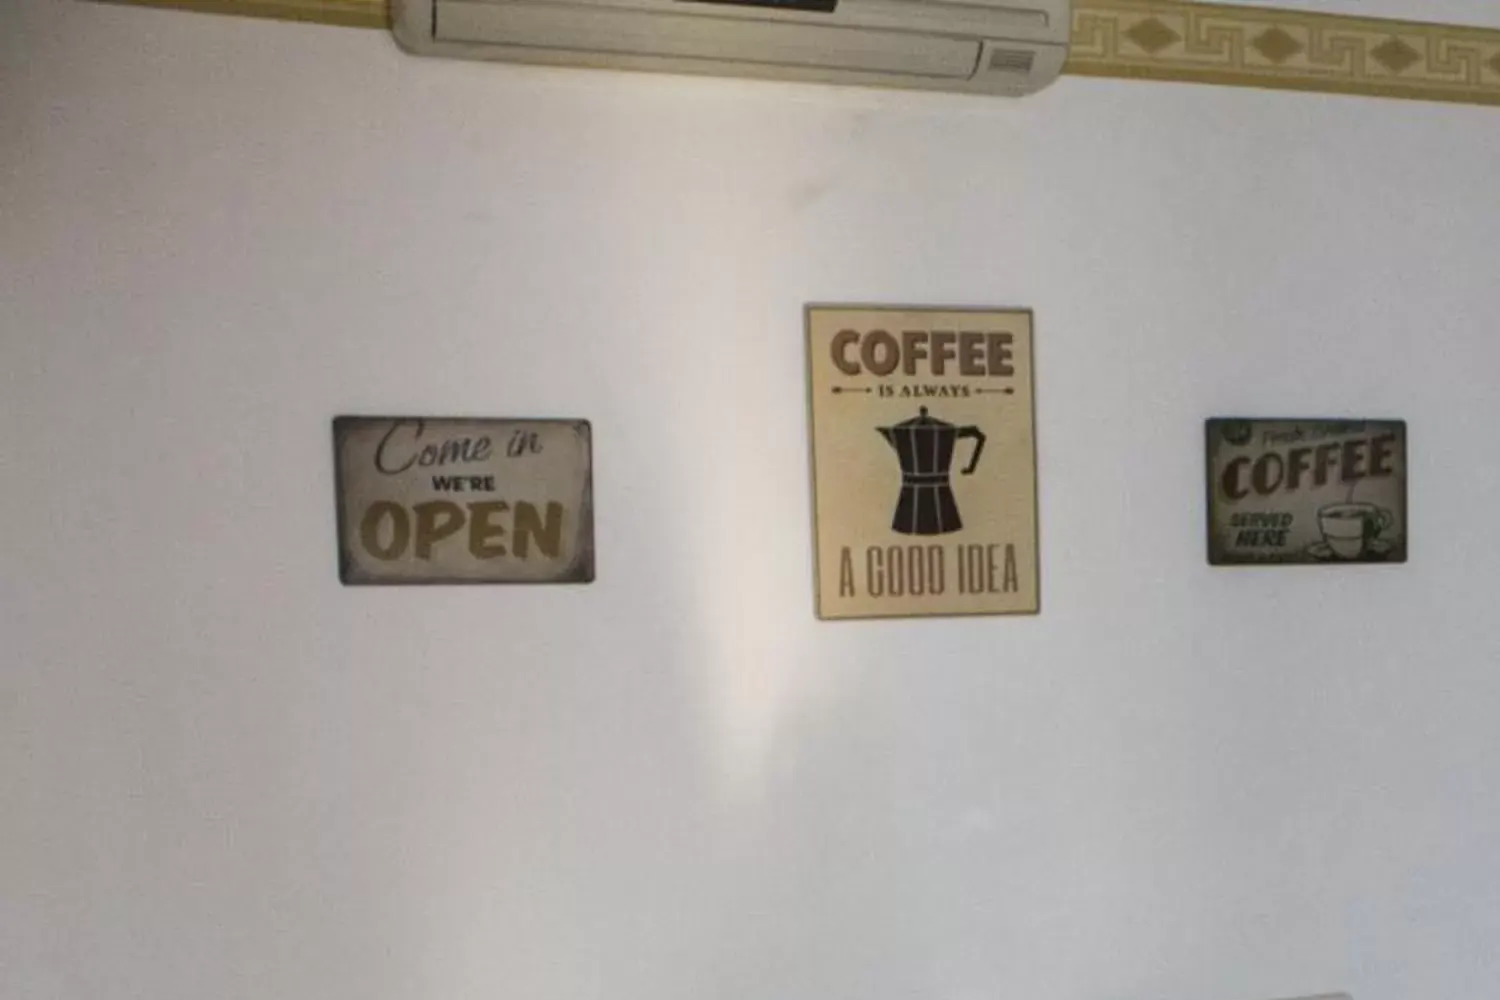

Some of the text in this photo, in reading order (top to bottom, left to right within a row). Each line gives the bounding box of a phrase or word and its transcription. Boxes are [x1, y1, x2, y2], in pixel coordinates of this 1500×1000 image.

[830, 329, 1015, 377] COFFEE
[879, 384, 972, 398] IS ALWAYS
[374, 417, 544, 475] Come in
[1221, 432, 1396, 501] COFFEE
[432, 475, 495, 492] WE'RE
[359, 500, 564, 561] OPEN
[840, 543, 1019, 598] A GOOD IDEA
